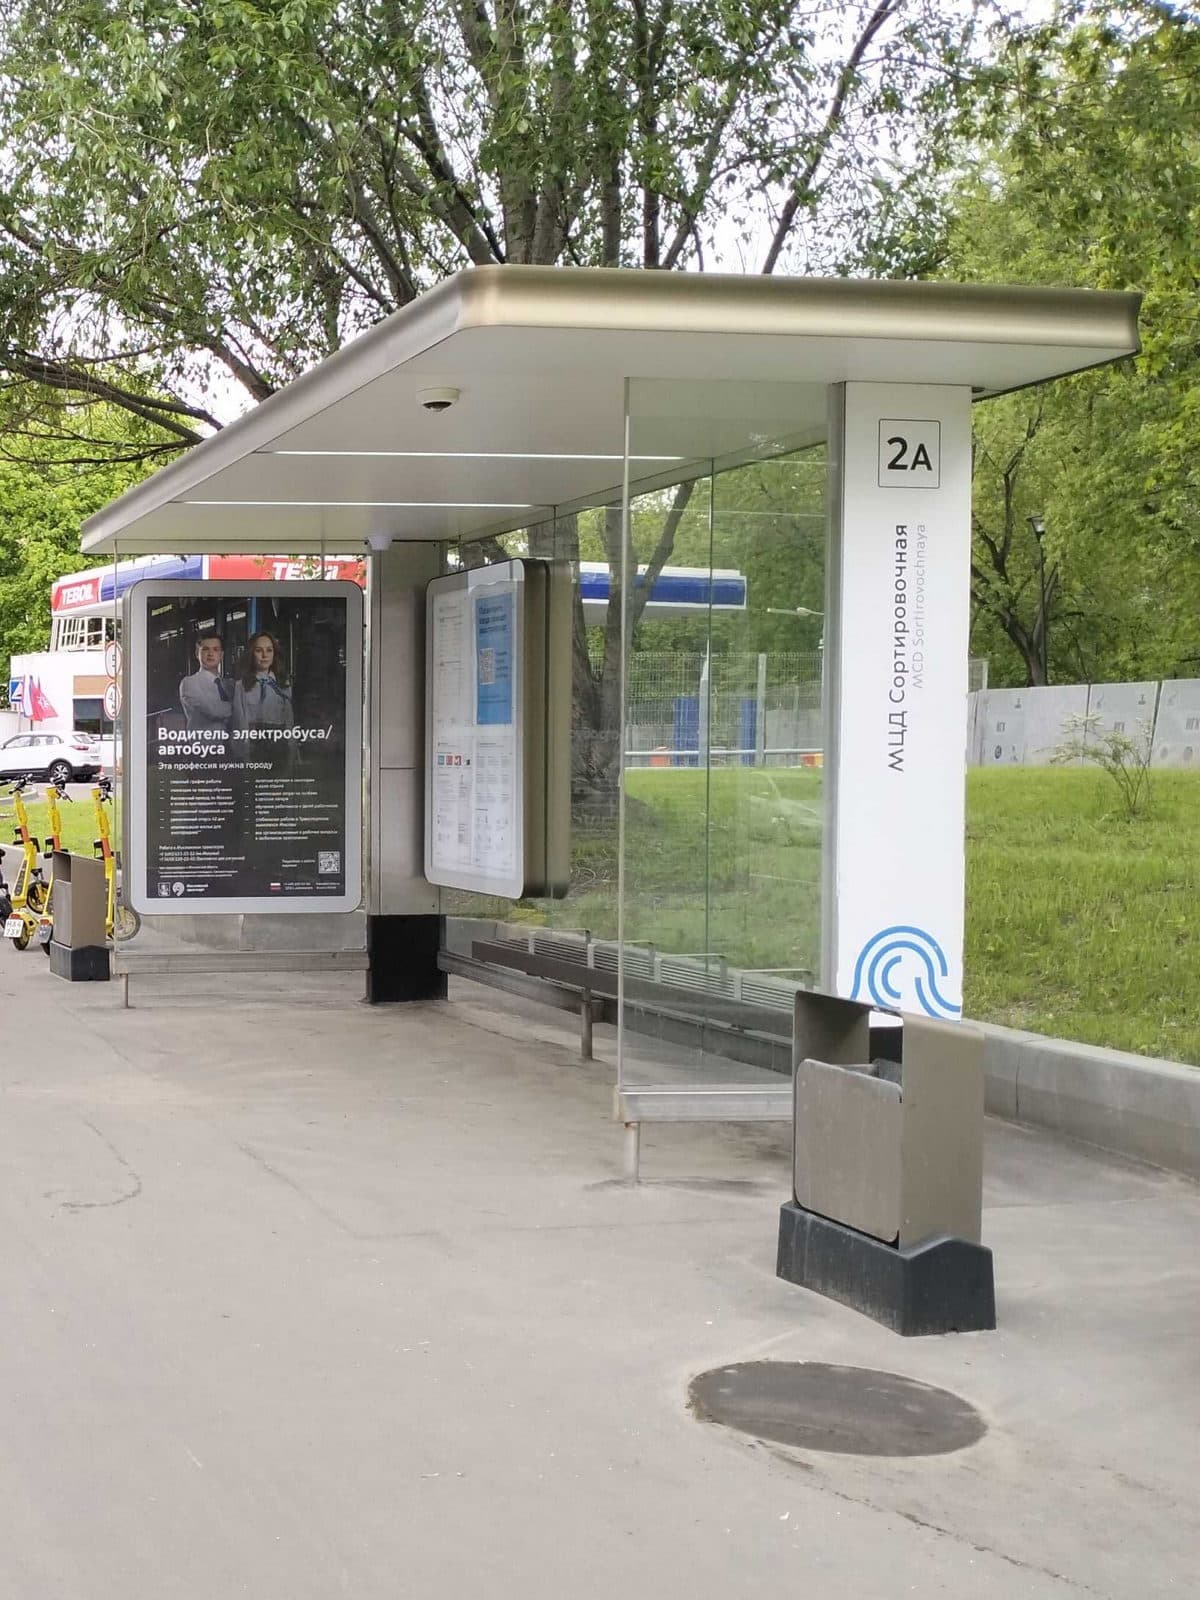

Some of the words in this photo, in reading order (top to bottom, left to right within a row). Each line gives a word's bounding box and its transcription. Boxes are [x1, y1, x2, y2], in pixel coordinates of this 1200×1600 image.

[889, 524, 910, 703] Сортировочная
[912, 652, 924, 689] MCD
[158, 727, 230, 742] Водитель
[233, 725, 333, 743] электробуса/
[888, 710, 907, 772] МЦД
[158, 742, 225, 758] автобуса
[158, 762, 172, 770] Эта
[174, 762, 217, 771] профессия
[219, 762, 244, 770] нужна
[246, 762, 274, 771] городу
